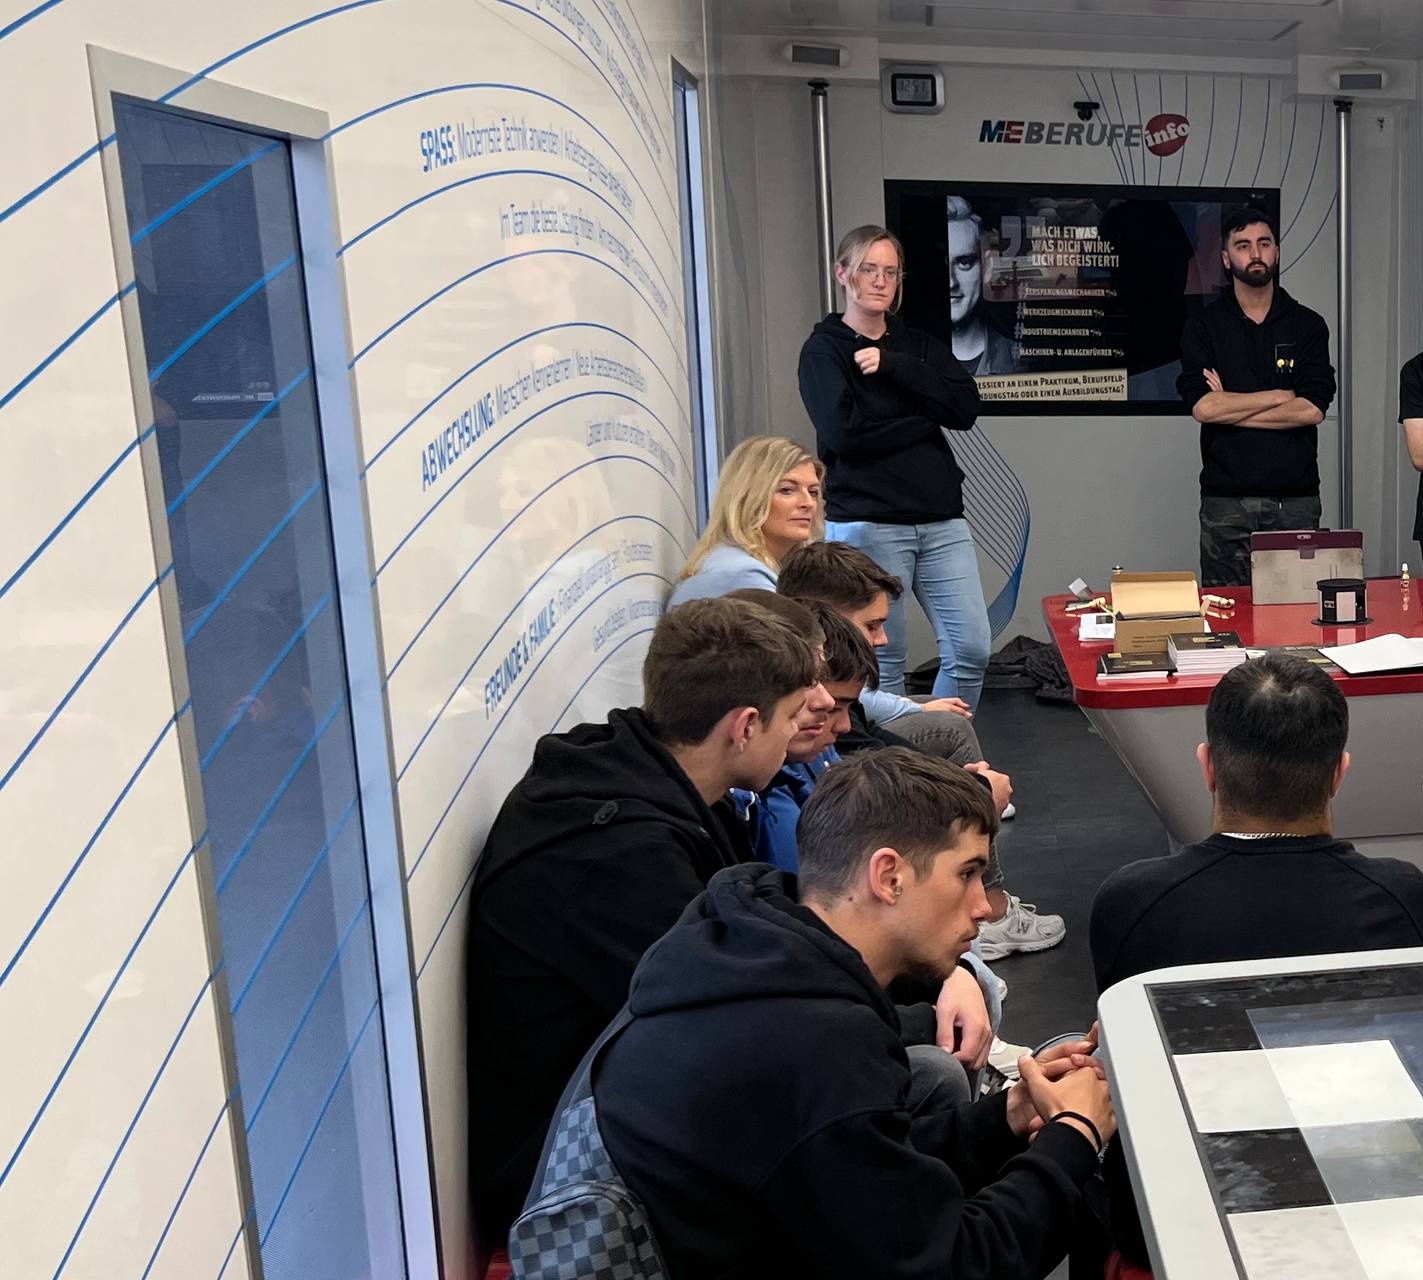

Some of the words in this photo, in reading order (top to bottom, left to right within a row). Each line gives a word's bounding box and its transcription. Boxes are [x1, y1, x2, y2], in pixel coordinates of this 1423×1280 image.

[979, 119, 1143, 147] MEBERUFE
[1145, 122, 1190, 148] info
[420, 124, 457, 173] SPASS:
[501, 115, 527, 151] Technik
[1031, 226, 1060, 238] MACH
[1063, 226, 1100, 241] ETWAS,
[1031, 240, 1054, 252] WAS
[1057, 240, 1080, 253] DICH
[1083, 241, 1115, 253] WIRK-
[1032, 254, 1054, 266] LICH
[1056, 254, 1119, 267] BEGEISTERT!
[977, 381, 1005, 390] ESSIERT
[1007, 380, 1016, 388] AN
[1017, 379, 1038, 388] EINEM
[979, 391, 1019, 400] NDUNGSTAG
[1020, 390, 1039, 399] ODER
[1040, 388, 1061, 397] EINEM
[421, 392, 496, 492] ABWECHSLUNG:
[484, 640, 522, 719] FREUNDE
[522, 632, 529, 664] &
